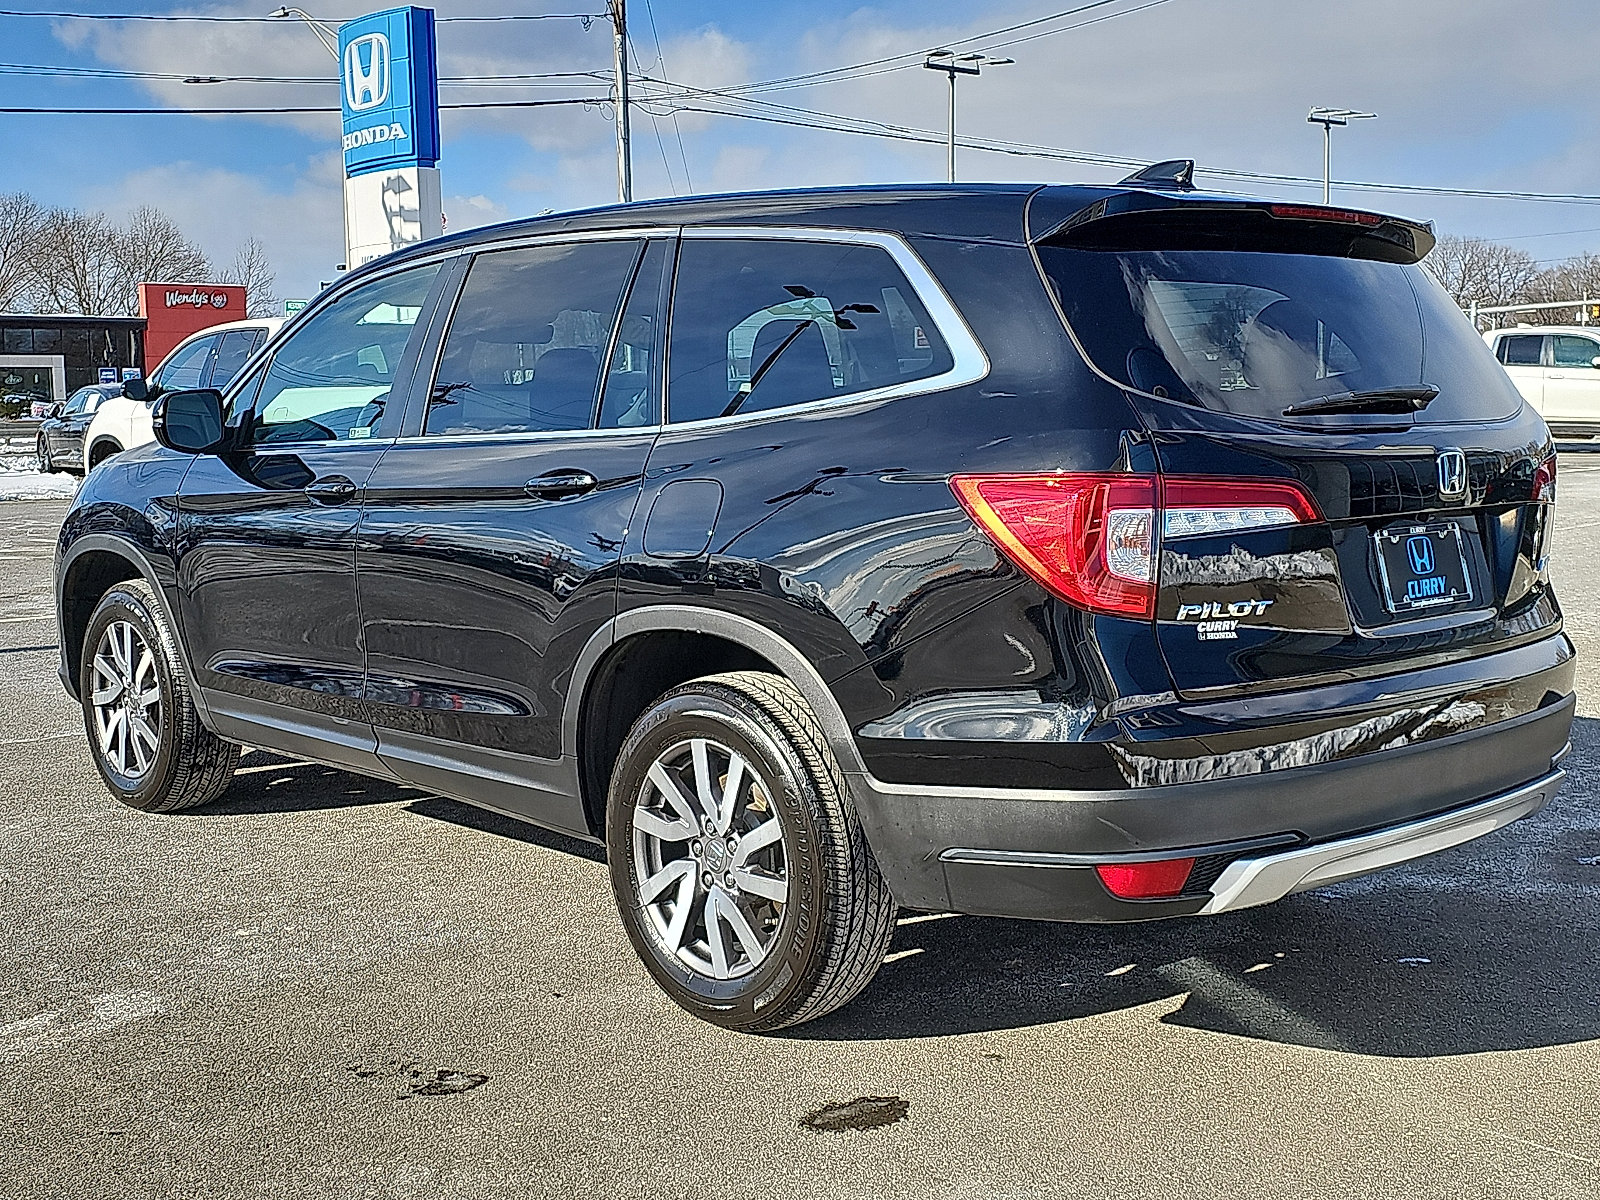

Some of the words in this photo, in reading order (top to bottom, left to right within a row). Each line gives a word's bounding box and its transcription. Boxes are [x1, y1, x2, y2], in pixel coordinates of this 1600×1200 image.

[343, 122, 408, 151] HONDA
[165, 288, 209, 308] Wendy's
[1407, 576, 1446, 599] CURRY
[1176, 599, 1274, 620] PILOT
[1197, 620, 1240, 632] CURRY
[1206, 632, 1239, 640] HONDA
